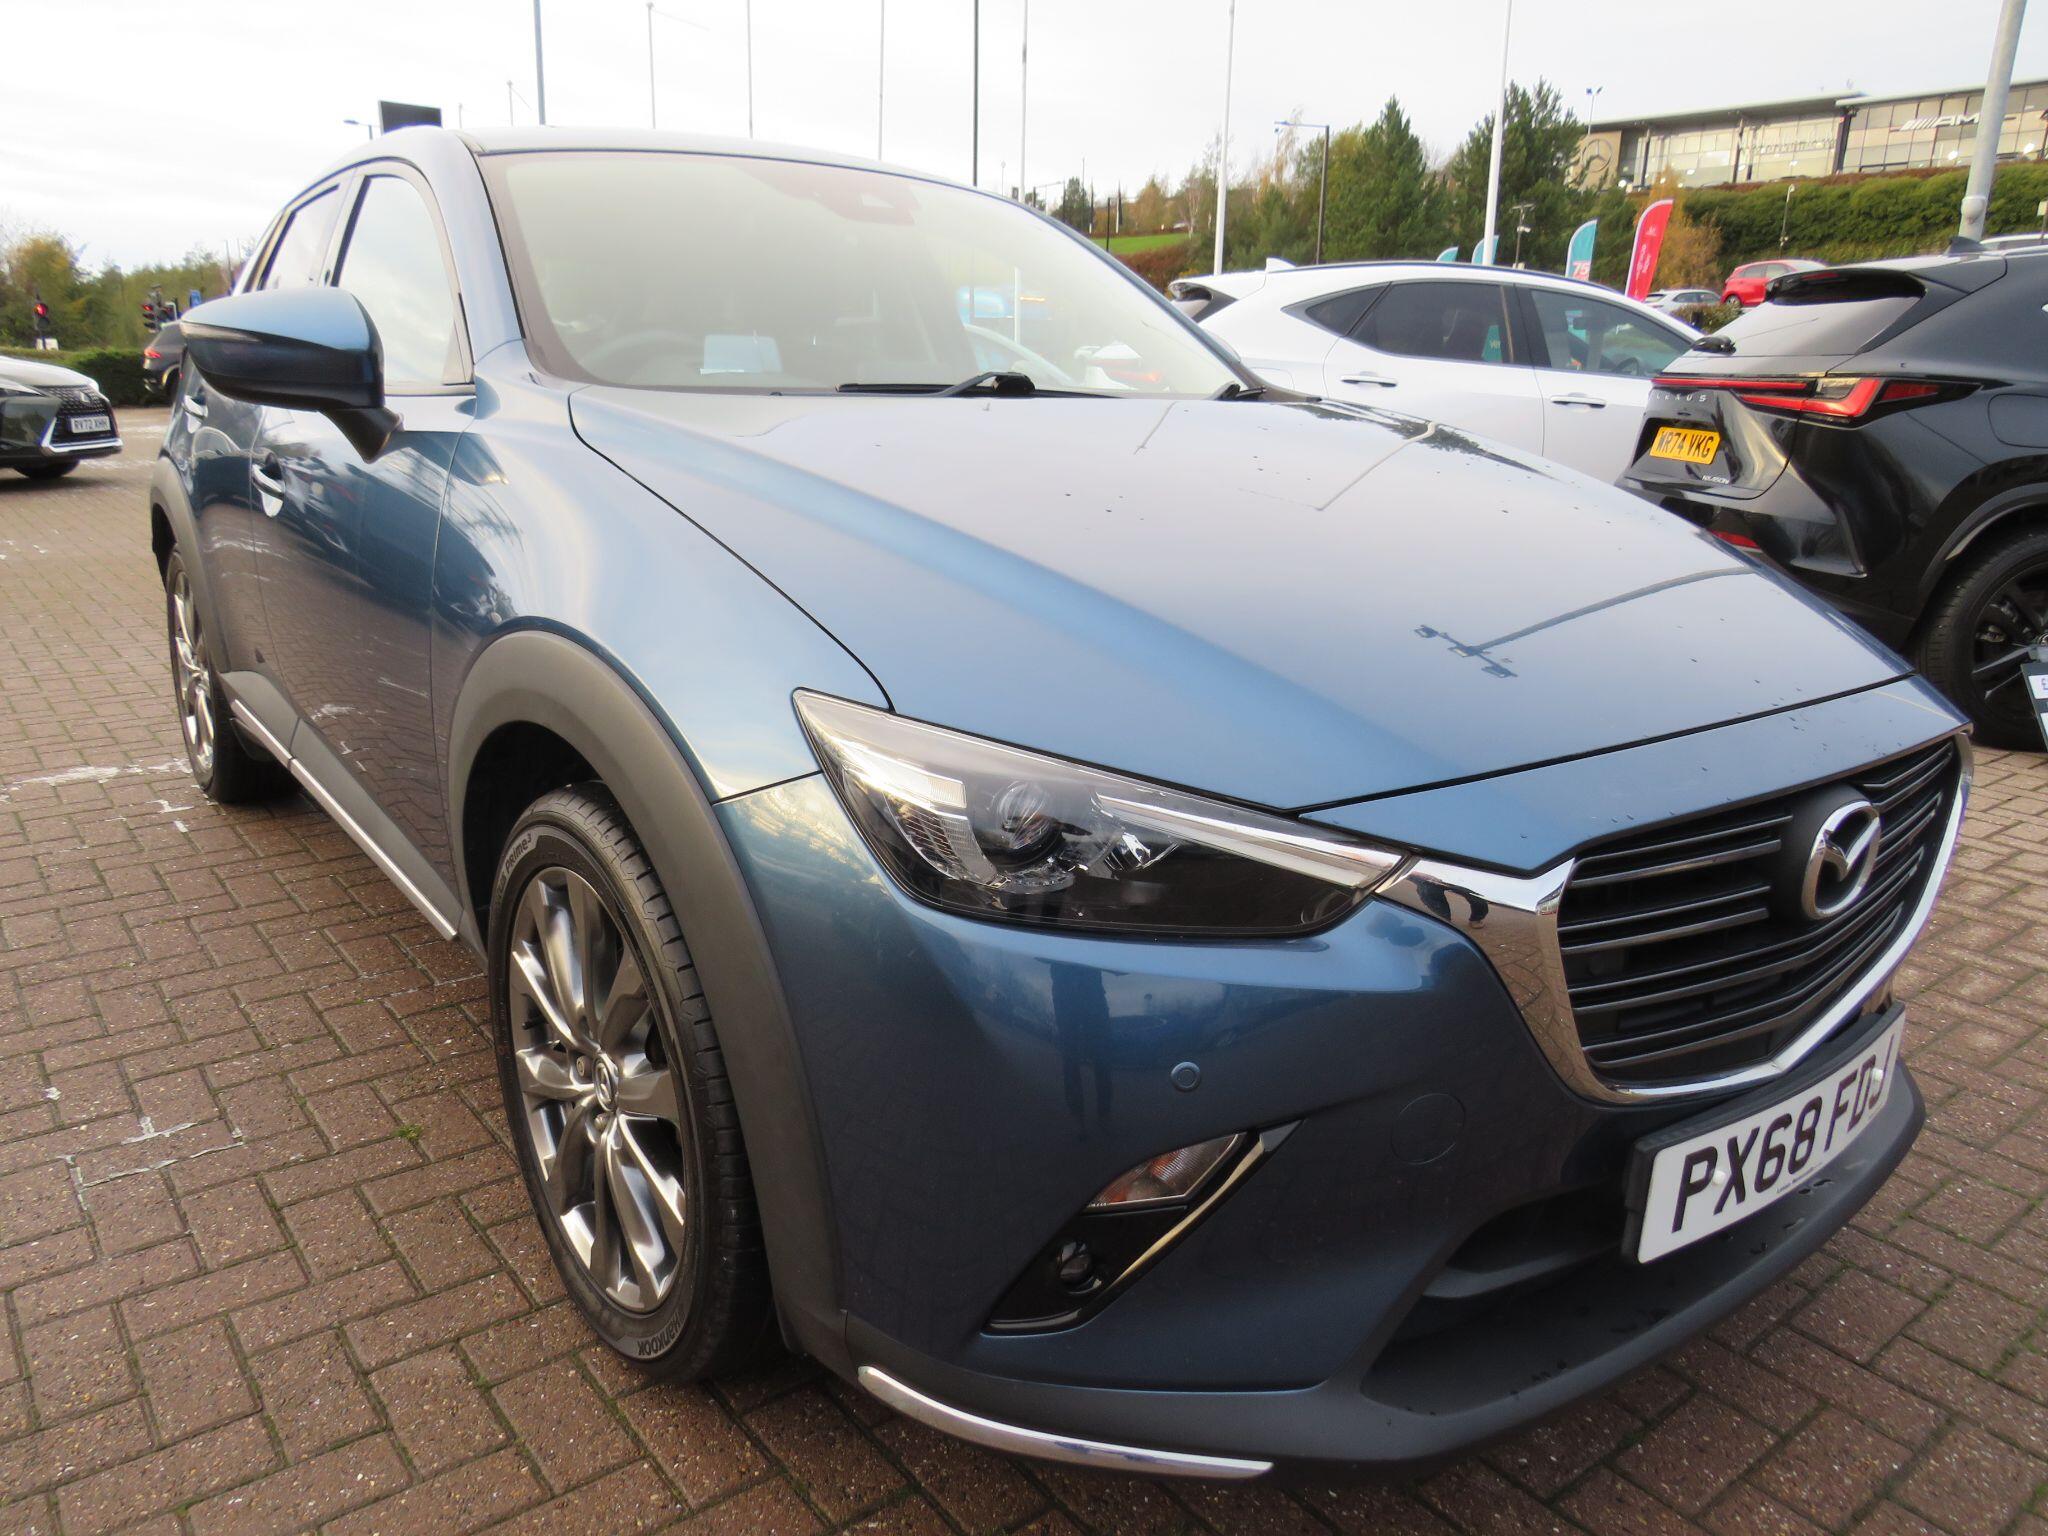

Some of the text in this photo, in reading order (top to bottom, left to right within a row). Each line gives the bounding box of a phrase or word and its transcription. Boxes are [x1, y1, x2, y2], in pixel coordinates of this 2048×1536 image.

[1573, 261, 1589, 276] 75
[1687, 433, 1714, 459] VKG
[1671, 1033, 1895, 1234] PX68 FDJ
